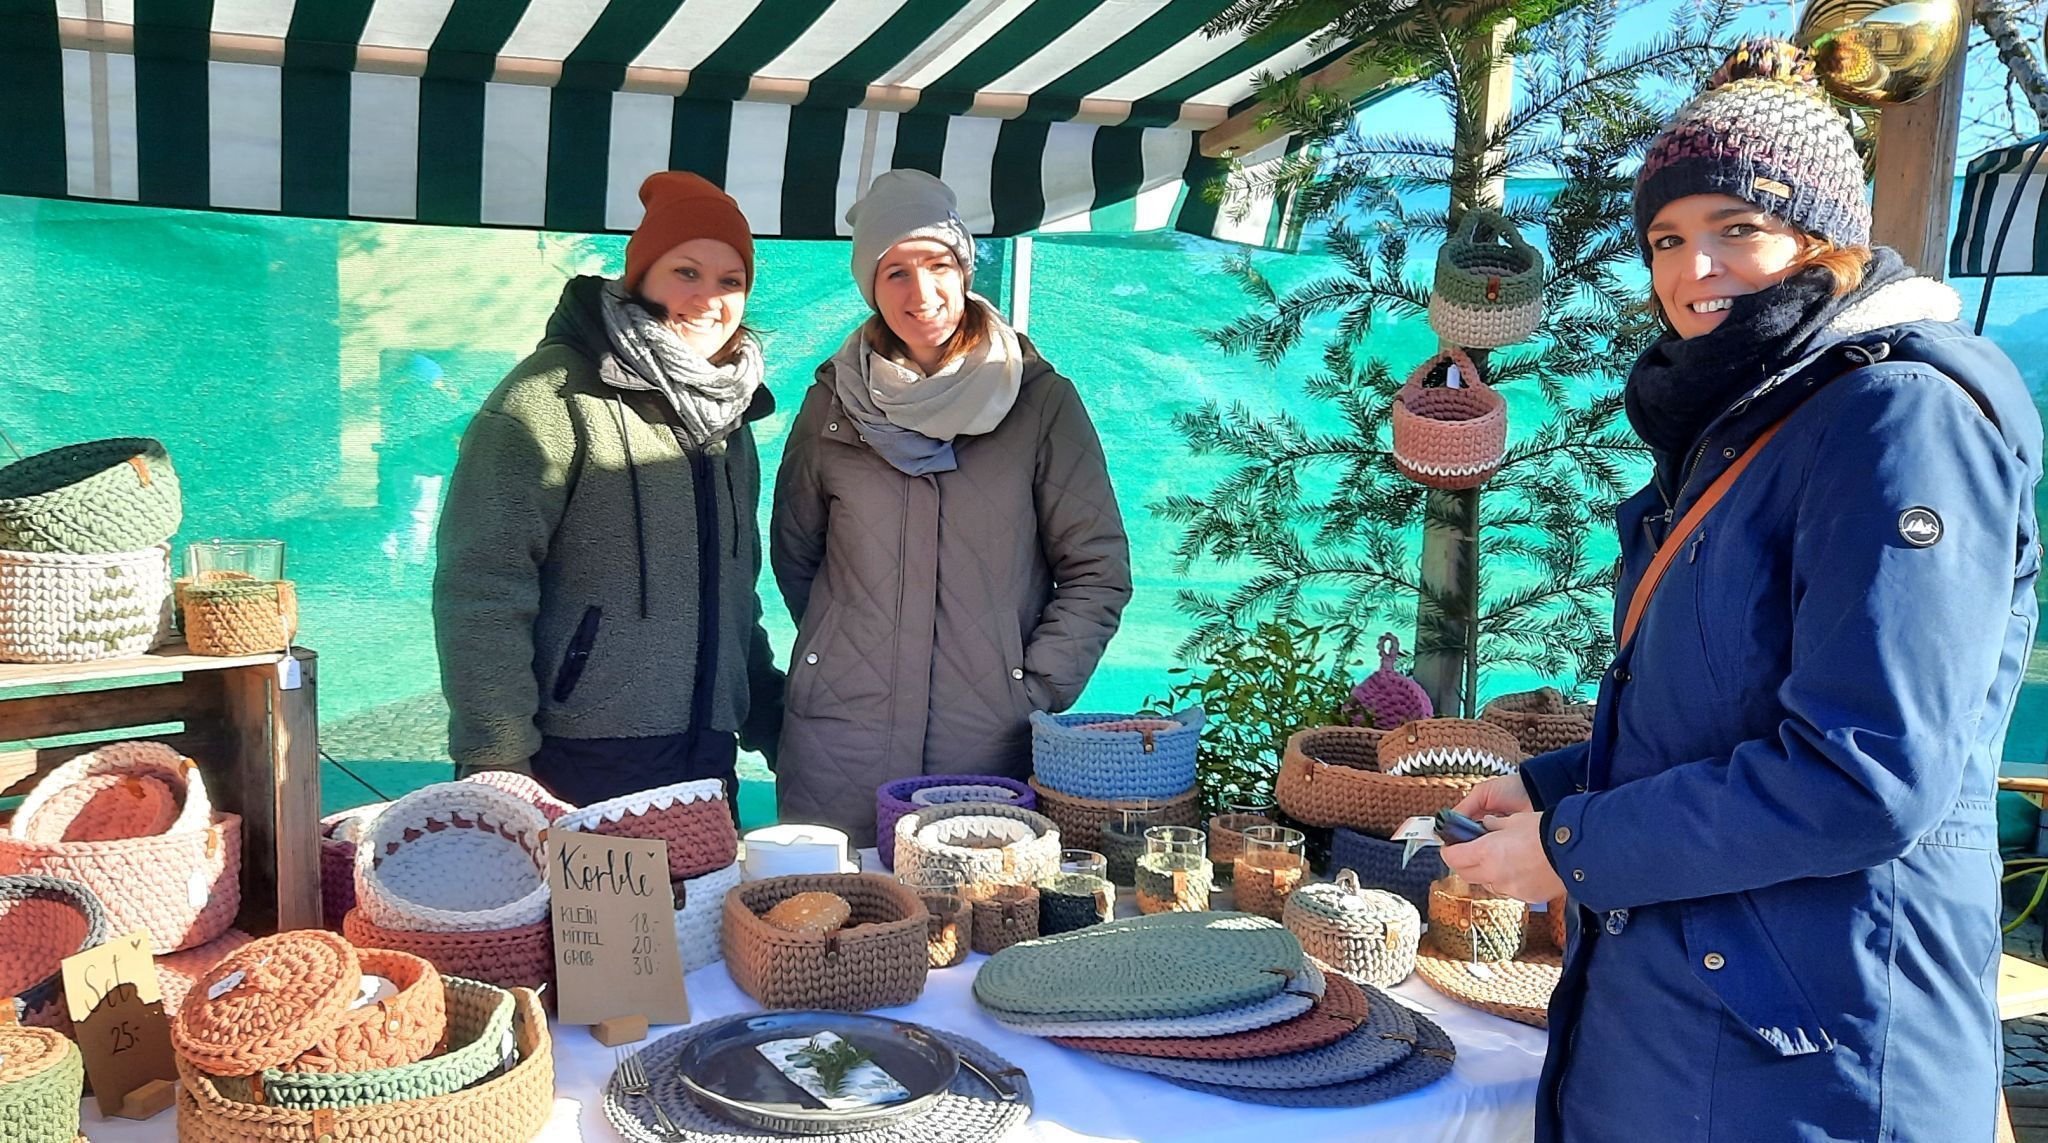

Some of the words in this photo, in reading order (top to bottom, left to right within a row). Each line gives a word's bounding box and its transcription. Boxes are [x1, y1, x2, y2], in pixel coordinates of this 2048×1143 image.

[557, 842, 654, 897] Körble
[561, 904, 598, 925] KLEIN
[562, 926, 604, 946] MITTEL
[84, 954, 131, 1014] Set
